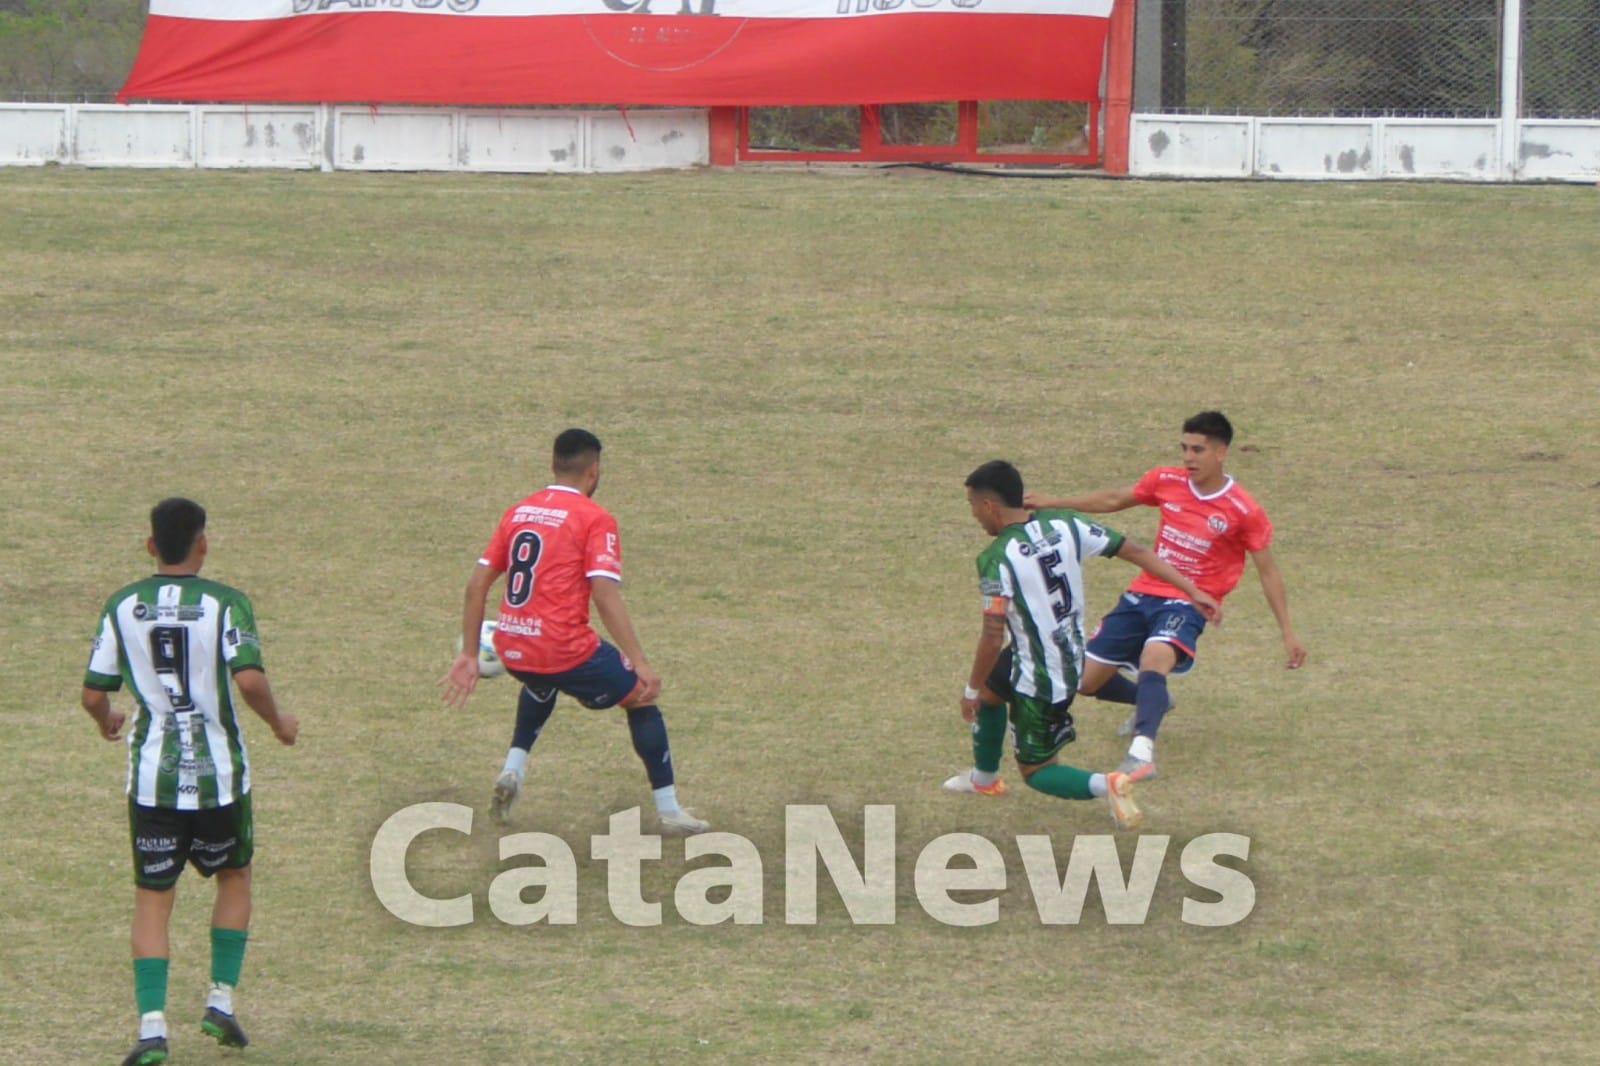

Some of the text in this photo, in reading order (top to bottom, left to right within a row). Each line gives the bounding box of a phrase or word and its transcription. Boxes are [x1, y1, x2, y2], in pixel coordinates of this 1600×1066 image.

[506, 529, 544, 608] 8
[1037, 548, 1073, 624] 5
[149, 624, 196, 713] 9
